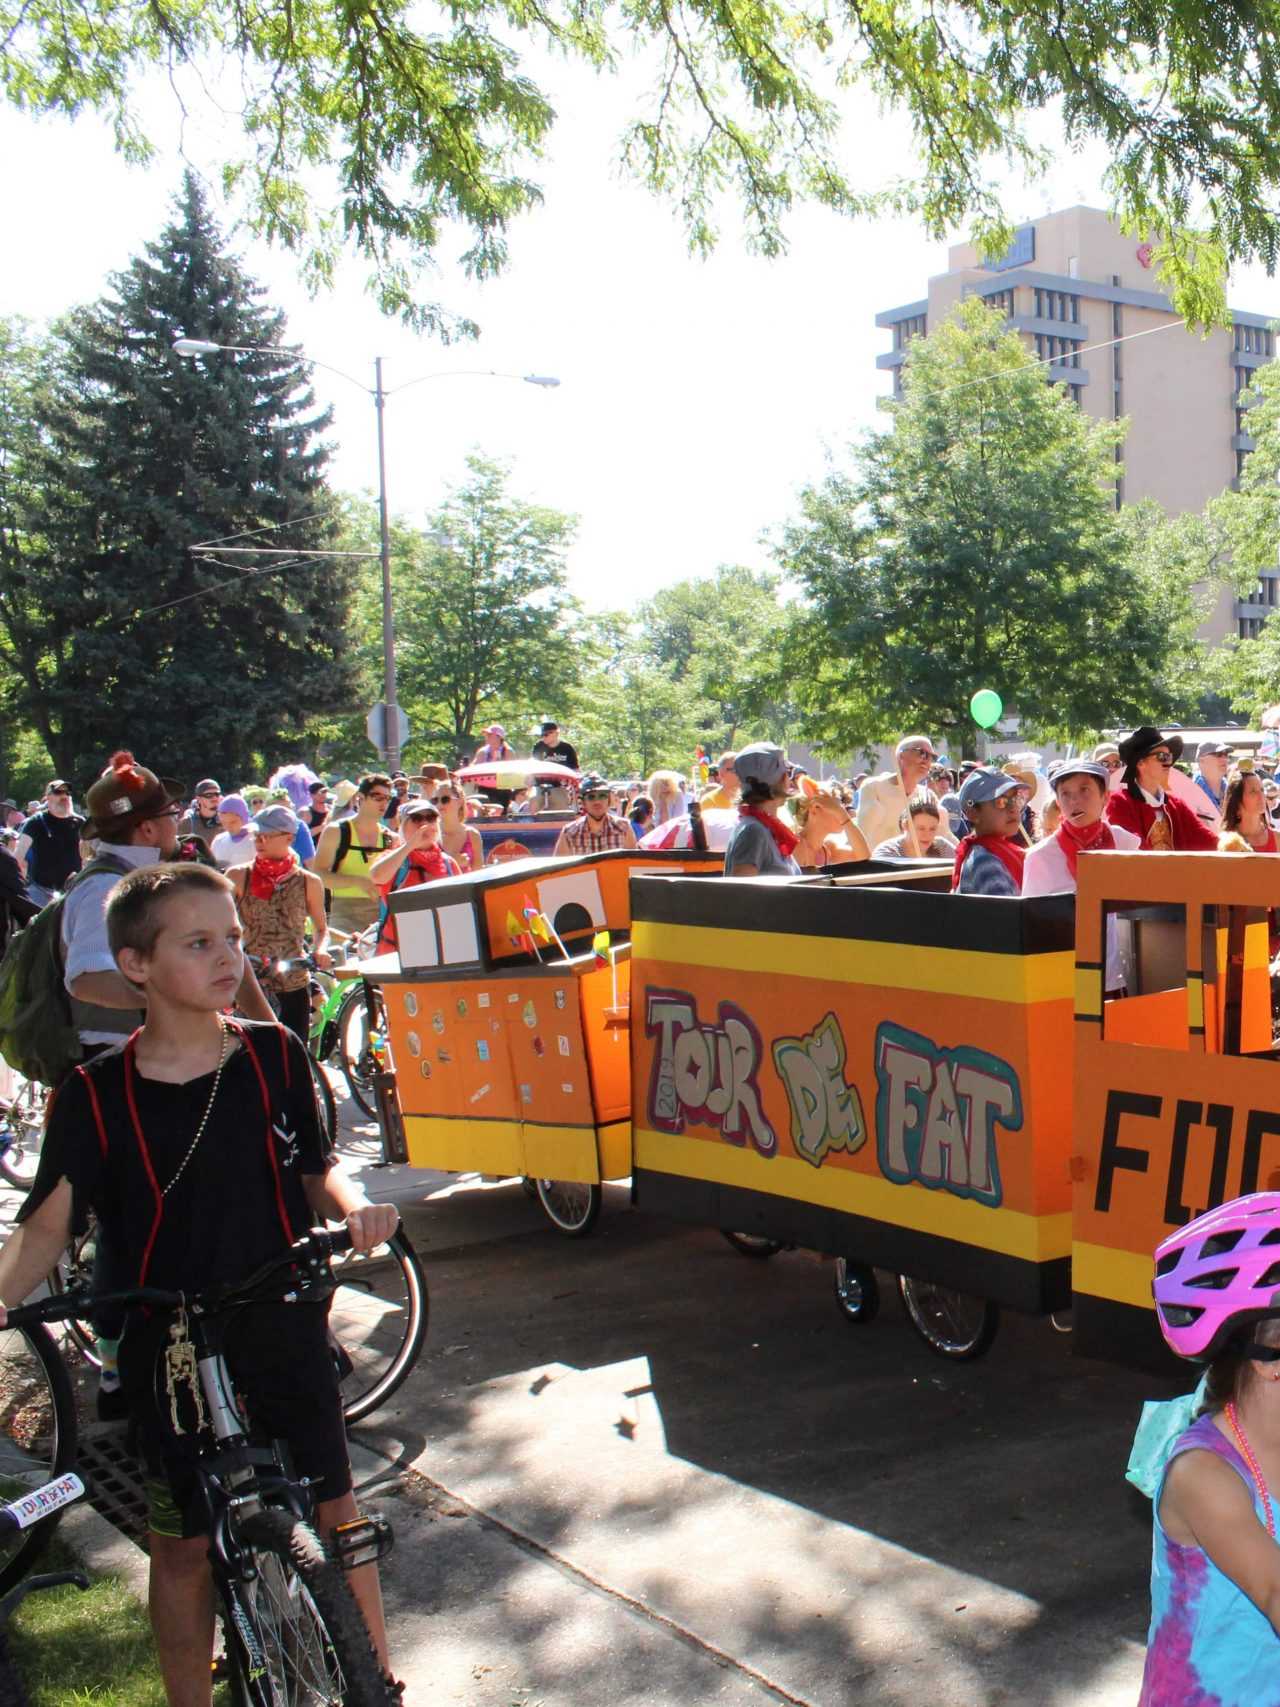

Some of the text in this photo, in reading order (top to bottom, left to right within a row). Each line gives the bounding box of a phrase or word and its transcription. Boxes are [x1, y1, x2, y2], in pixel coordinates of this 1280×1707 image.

[645, 985, 1025, 1209] TOUR DE FAT
[658, 1057, 675, 1114] 2019
